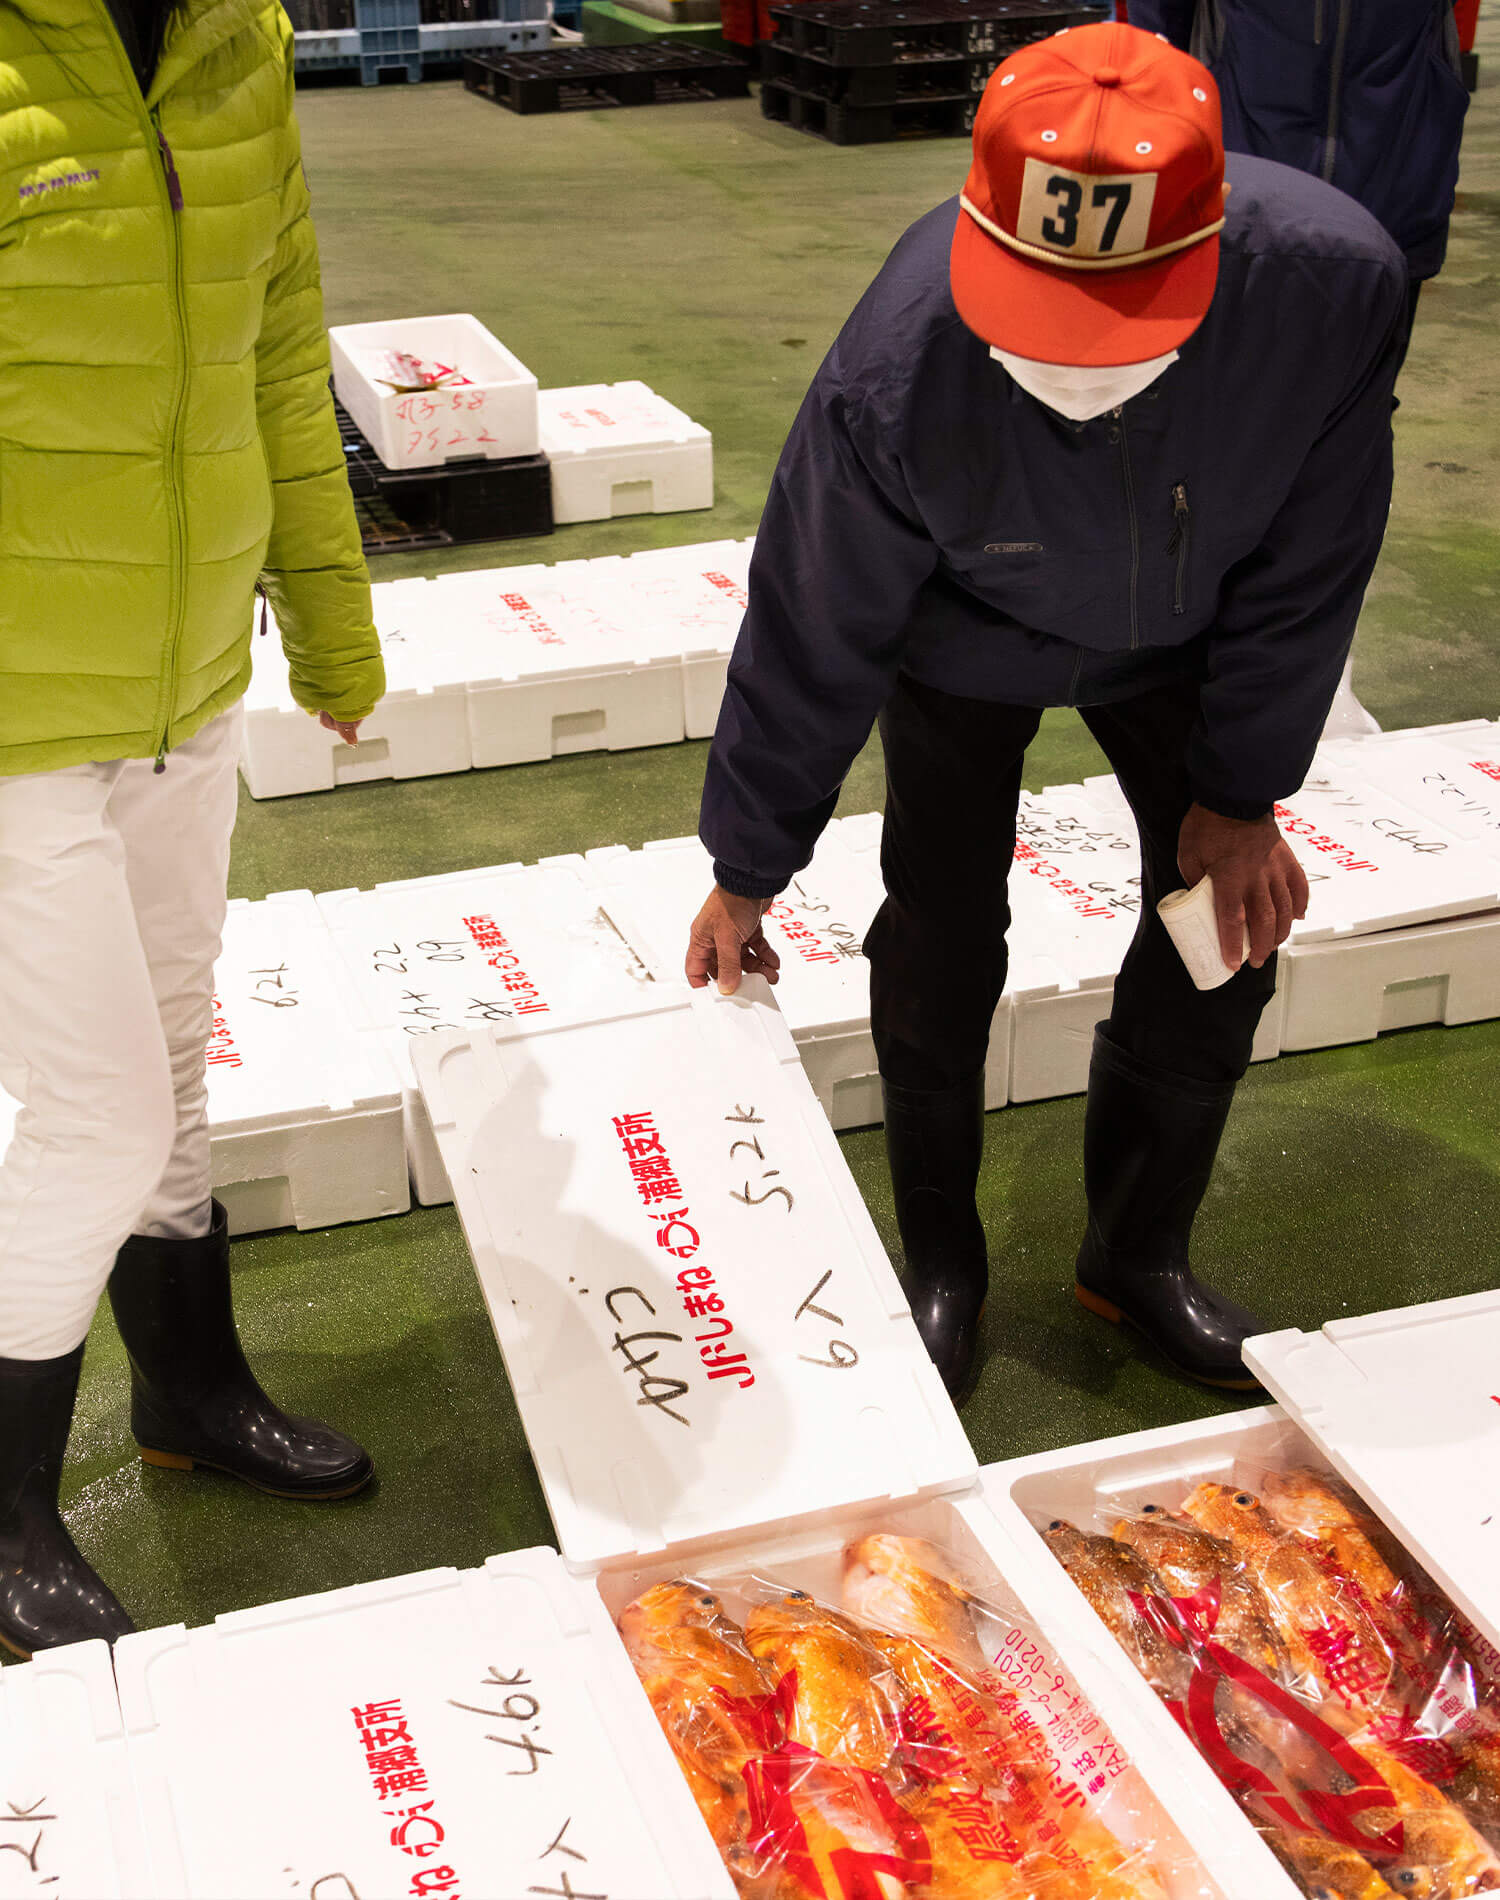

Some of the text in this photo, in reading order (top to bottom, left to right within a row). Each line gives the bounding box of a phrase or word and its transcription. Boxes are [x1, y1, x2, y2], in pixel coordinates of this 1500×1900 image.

[19, 168, 100, 199] MAMMUT
[1041, 175, 1132, 252] 37
[1071, 1750, 1106, 1796] 電話
[1093, 1735, 1129, 1778] FAX
